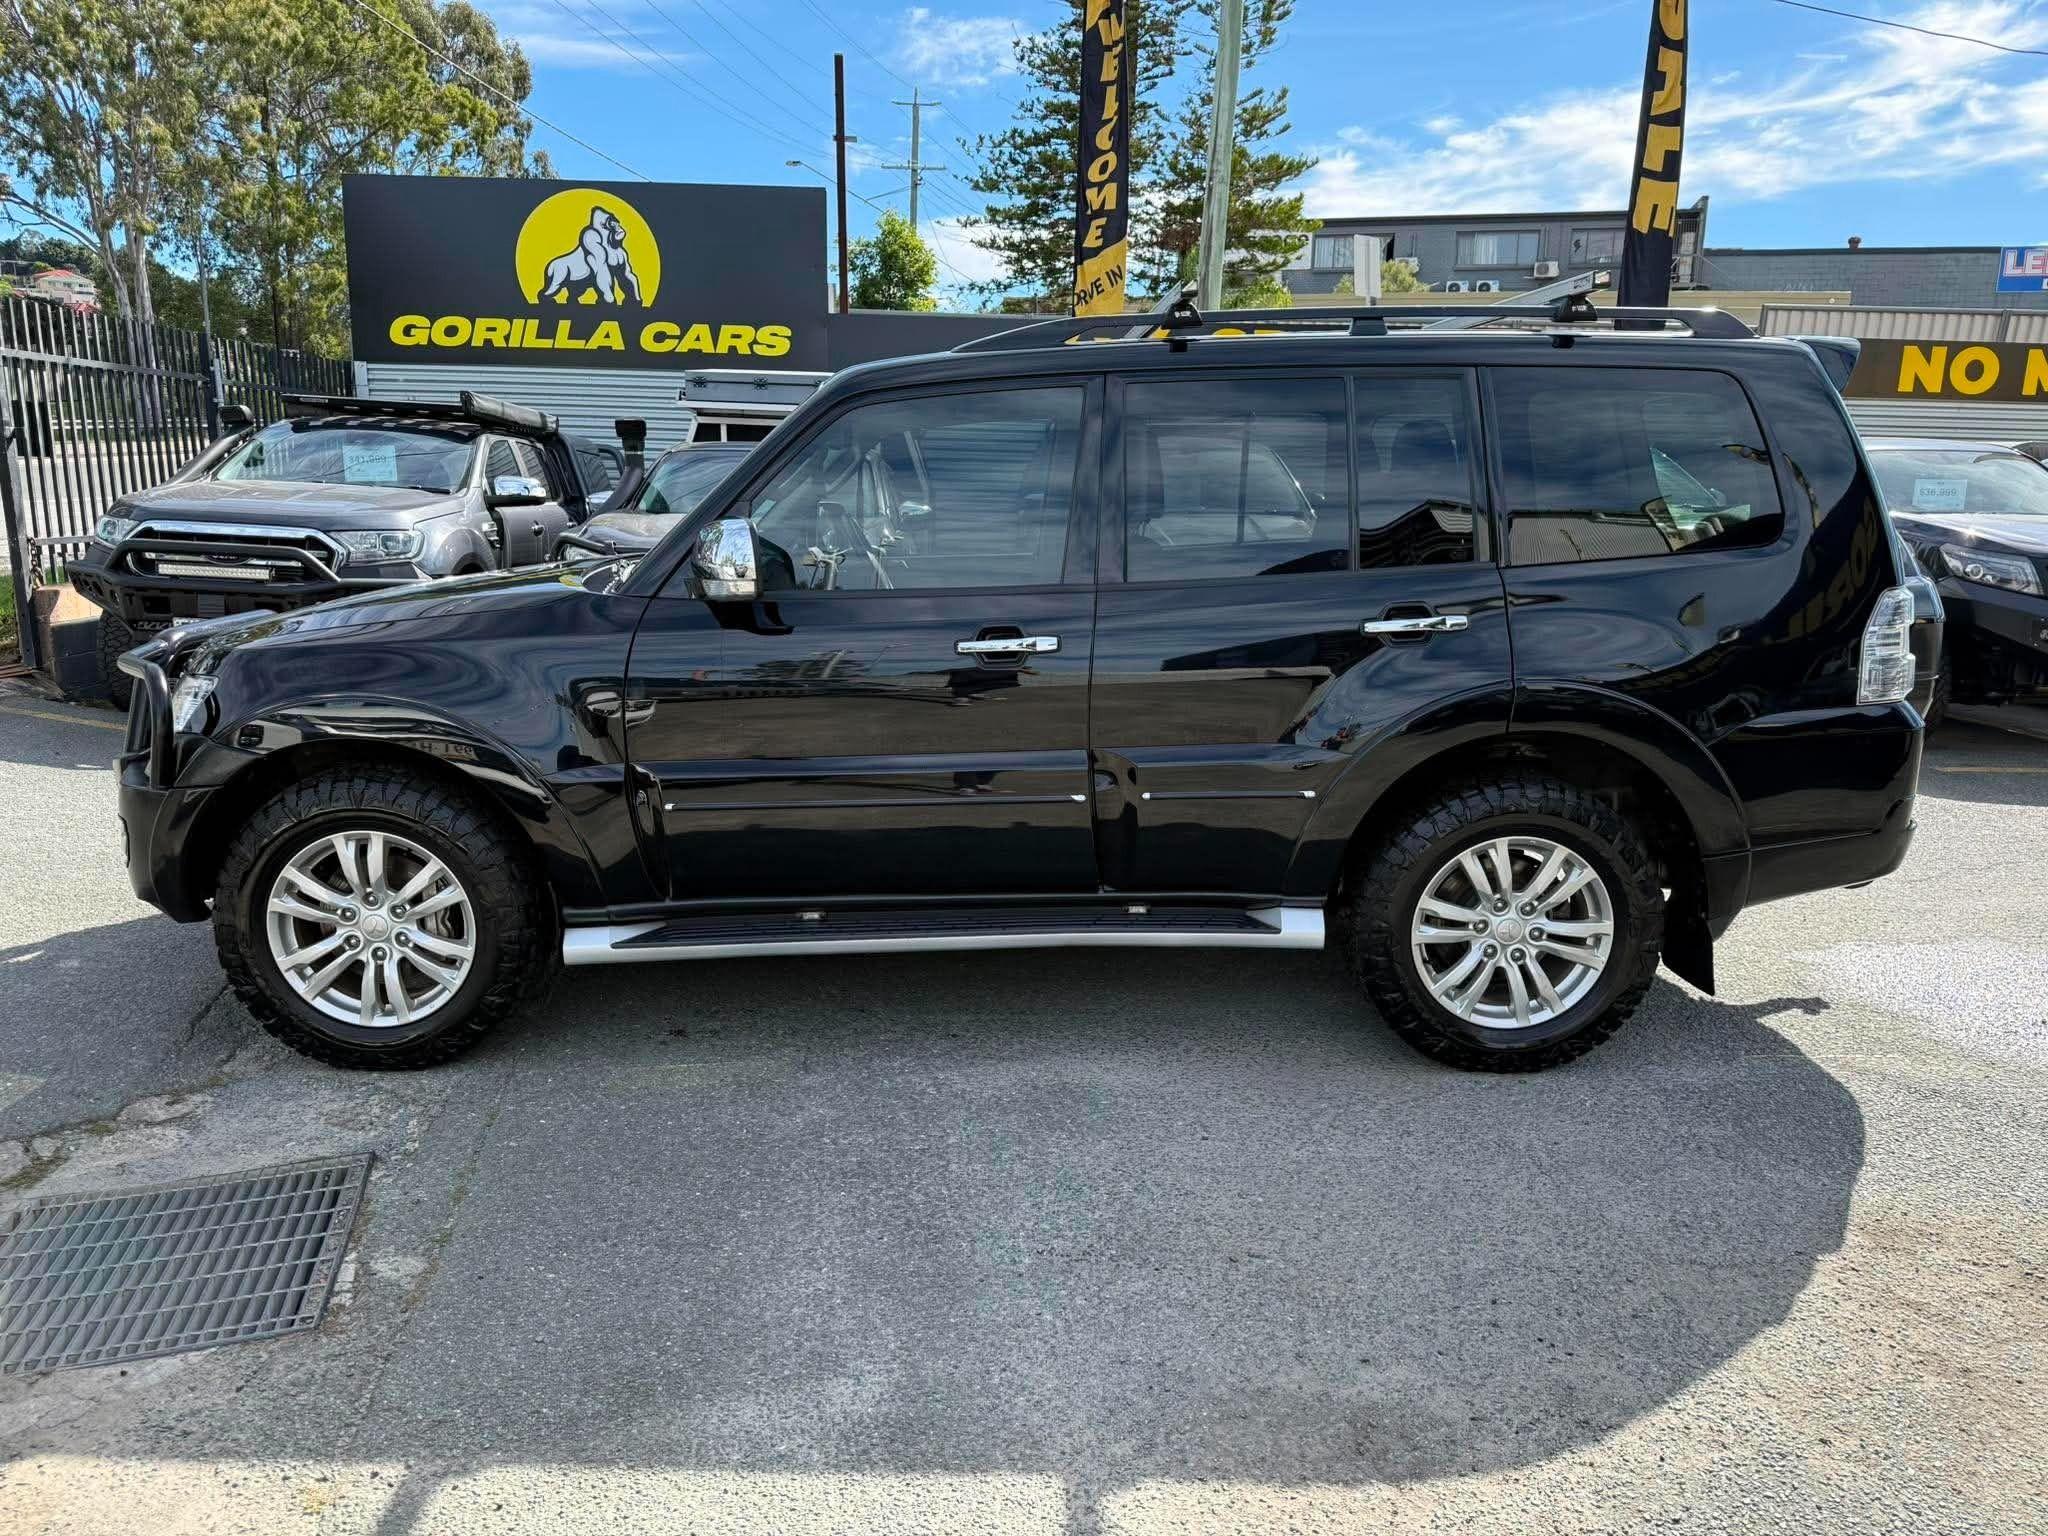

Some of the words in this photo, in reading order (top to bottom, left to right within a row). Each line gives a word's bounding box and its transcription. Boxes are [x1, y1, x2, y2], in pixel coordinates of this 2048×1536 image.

[1082, 12, 1124, 247] WELCOME
[1105, 264, 1123, 288] IN
[389, 314, 625, 350] GORILLA
[639, 321, 792, 356] CARS
[1897, 345, 2000, 395] NO
